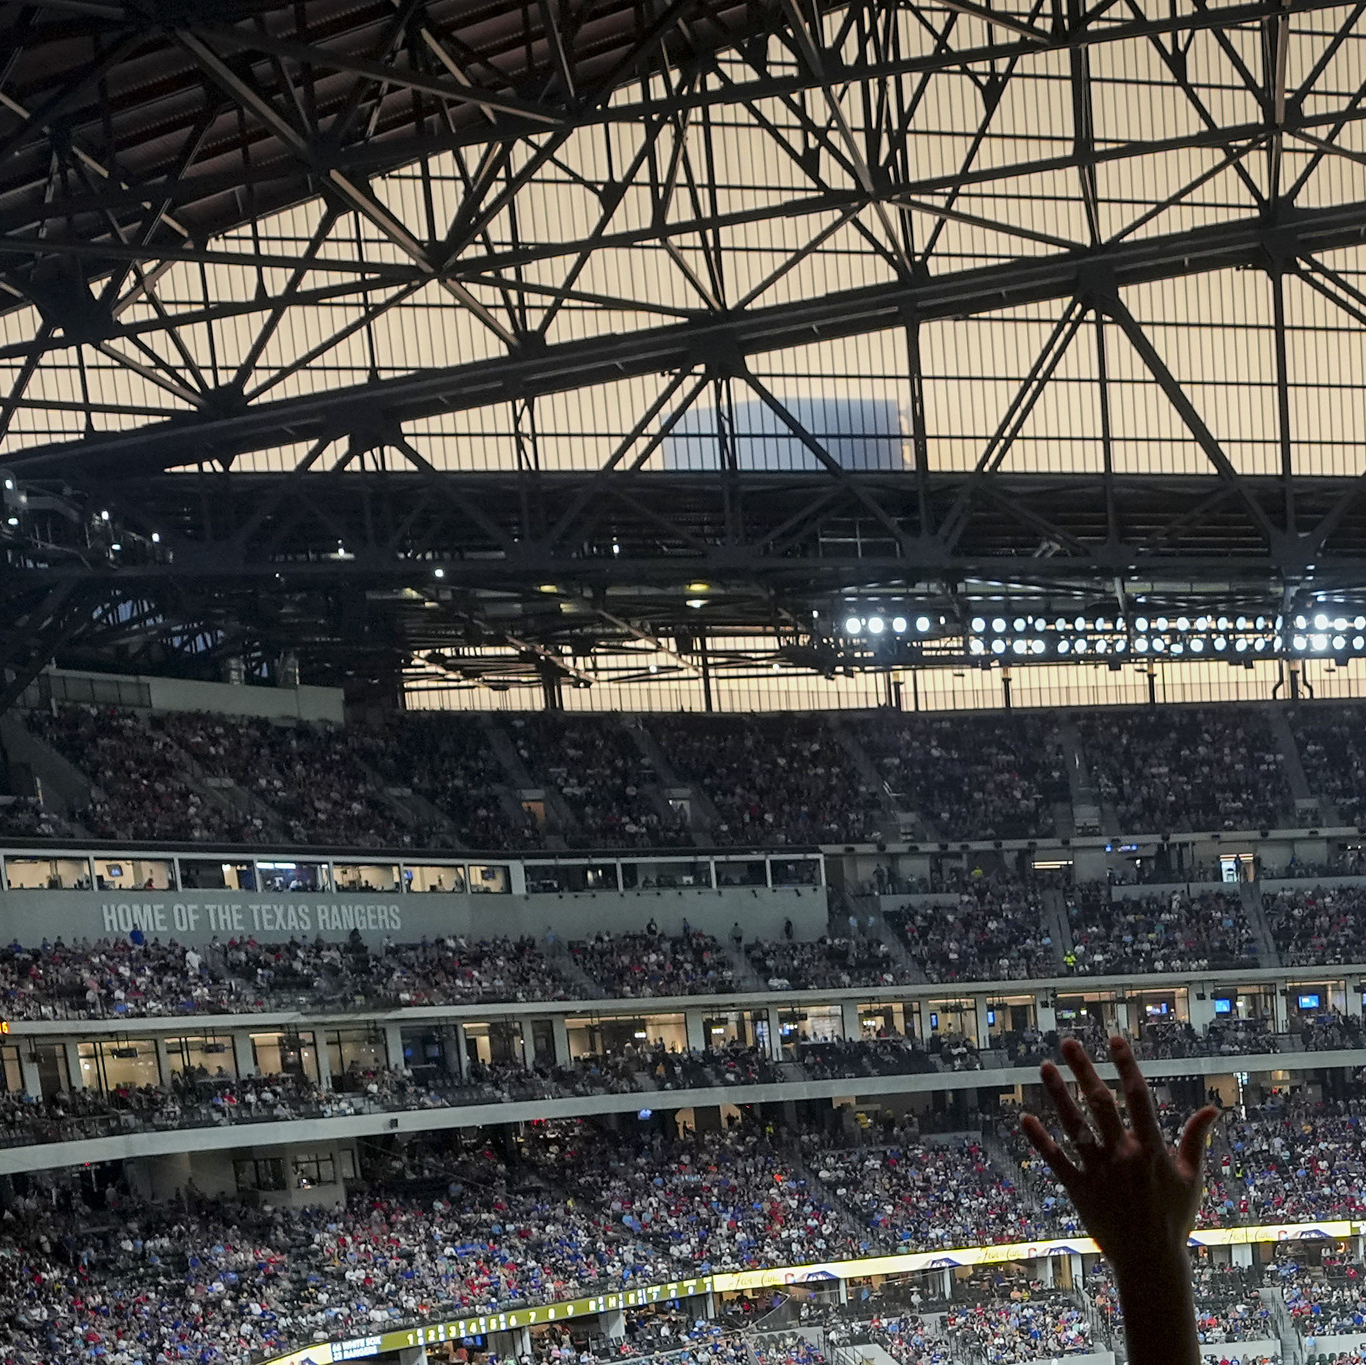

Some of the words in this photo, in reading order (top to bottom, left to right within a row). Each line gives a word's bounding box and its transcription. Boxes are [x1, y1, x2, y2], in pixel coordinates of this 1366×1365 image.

[102, 903, 168, 932] HOME
[172, 903, 200, 931] OF
[204, 904, 245, 931] THE
[248, 904, 312, 931] TEXAS
[316, 904, 402, 931] RANGERS
[529, 1311, 536, 1322] 7
